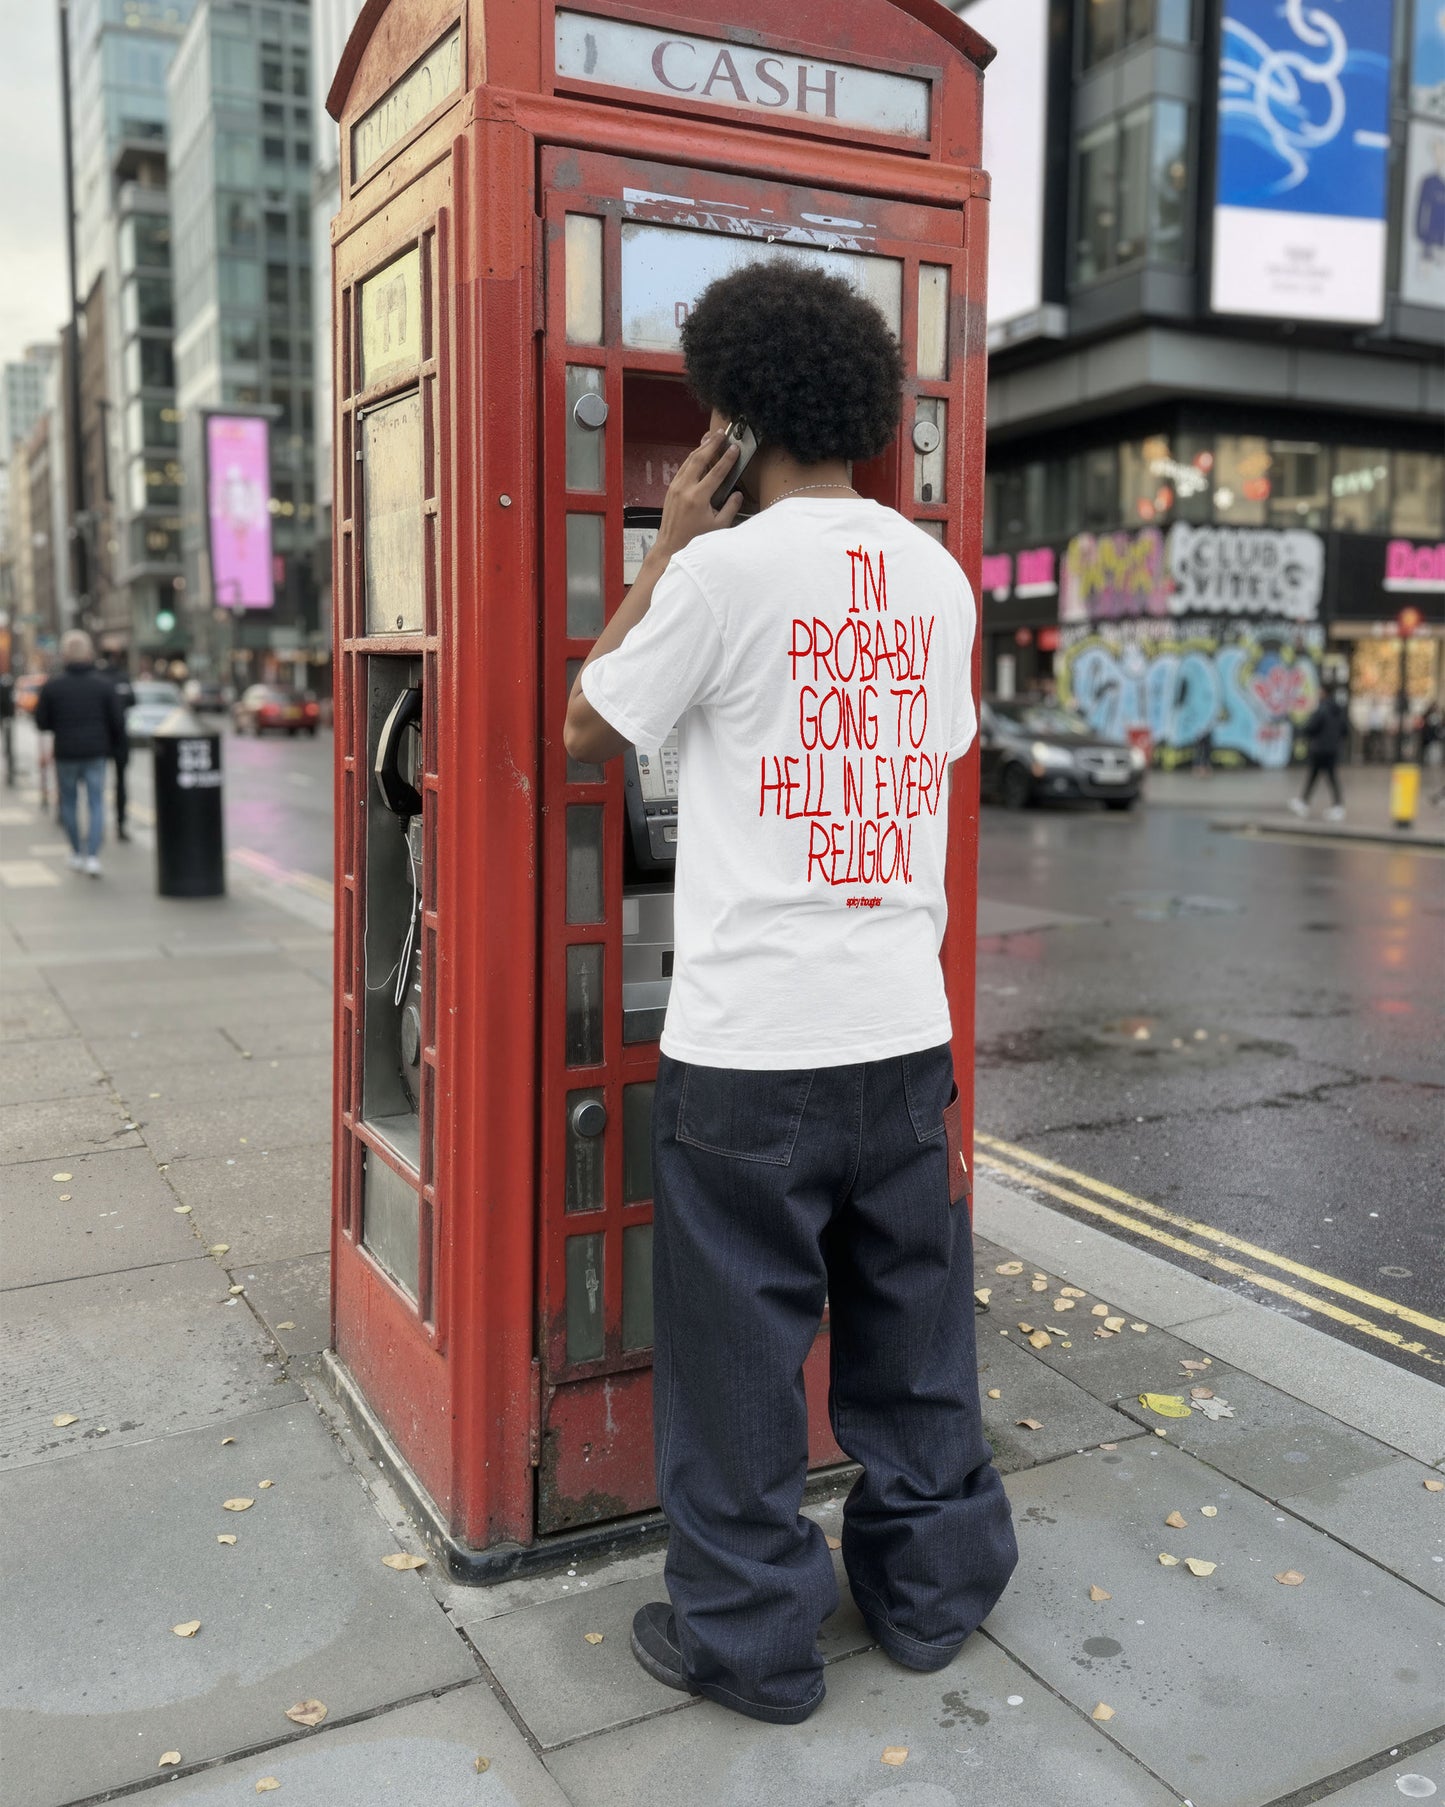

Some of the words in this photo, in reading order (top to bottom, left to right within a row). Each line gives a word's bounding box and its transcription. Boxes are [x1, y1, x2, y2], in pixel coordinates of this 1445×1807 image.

[651, 40, 838, 119] CASH
[846, 544, 887, 613] I'M
[787, 615, 935, 682] PROBABLY
[800, 685, 878, 750] GOING
[890, 684, 928, 749] TO
[759, 753, 832, 819] HELL
[844, 755, 863, 818] IN
[875, 751, 948, 819] EVERY
[808, 820, 912, 886] RELIGION.
